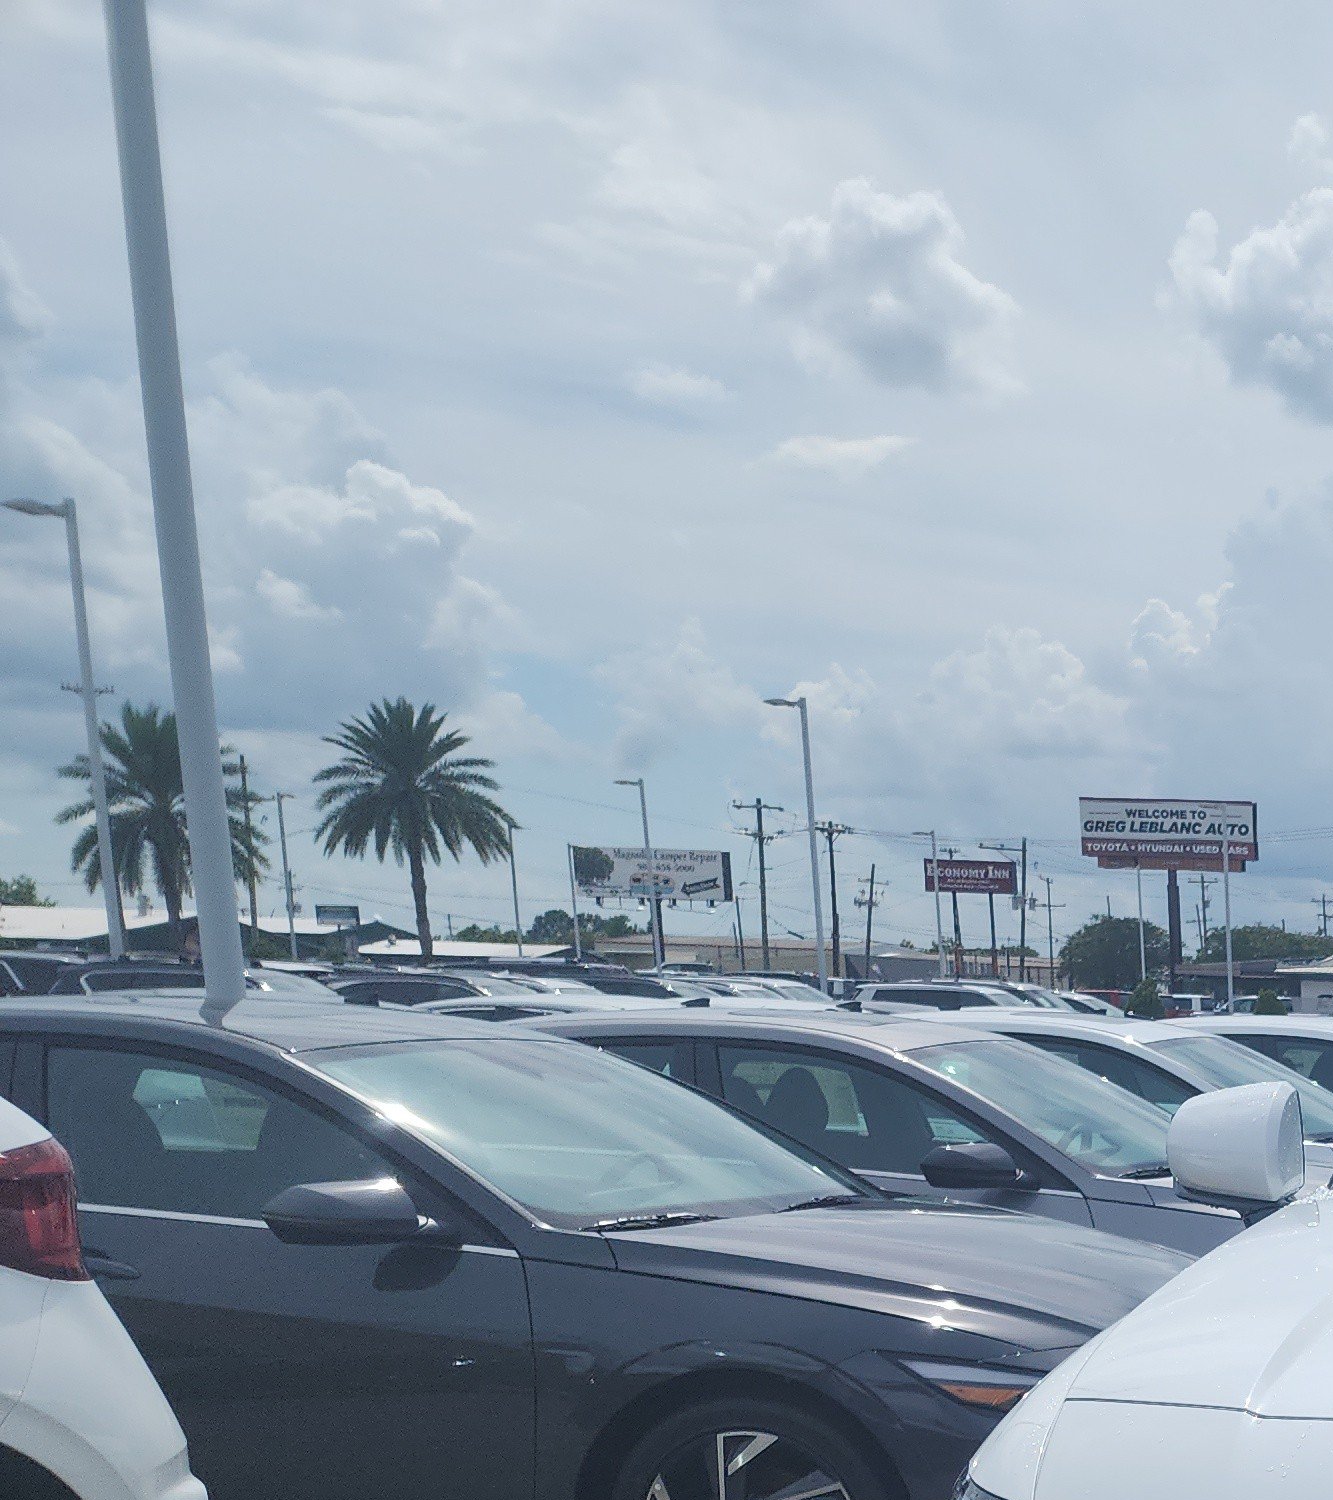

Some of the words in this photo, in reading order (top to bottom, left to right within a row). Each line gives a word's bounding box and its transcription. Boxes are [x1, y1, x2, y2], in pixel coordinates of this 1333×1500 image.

[1124, 808, 1187, 820] WELCOME
[1189, 810, 1207, 820] TO
[1083, 820, 1126, 833] GREG
[1129, 820, 1202, 835] LEBLANC
[1085, 842, 1129, 852] TOYOTA
[1137, 843, 1184, 853] HYUNDAI
[1192, 845, 1219, 854] USED
[1221, 846, 1249, 855] ARS
